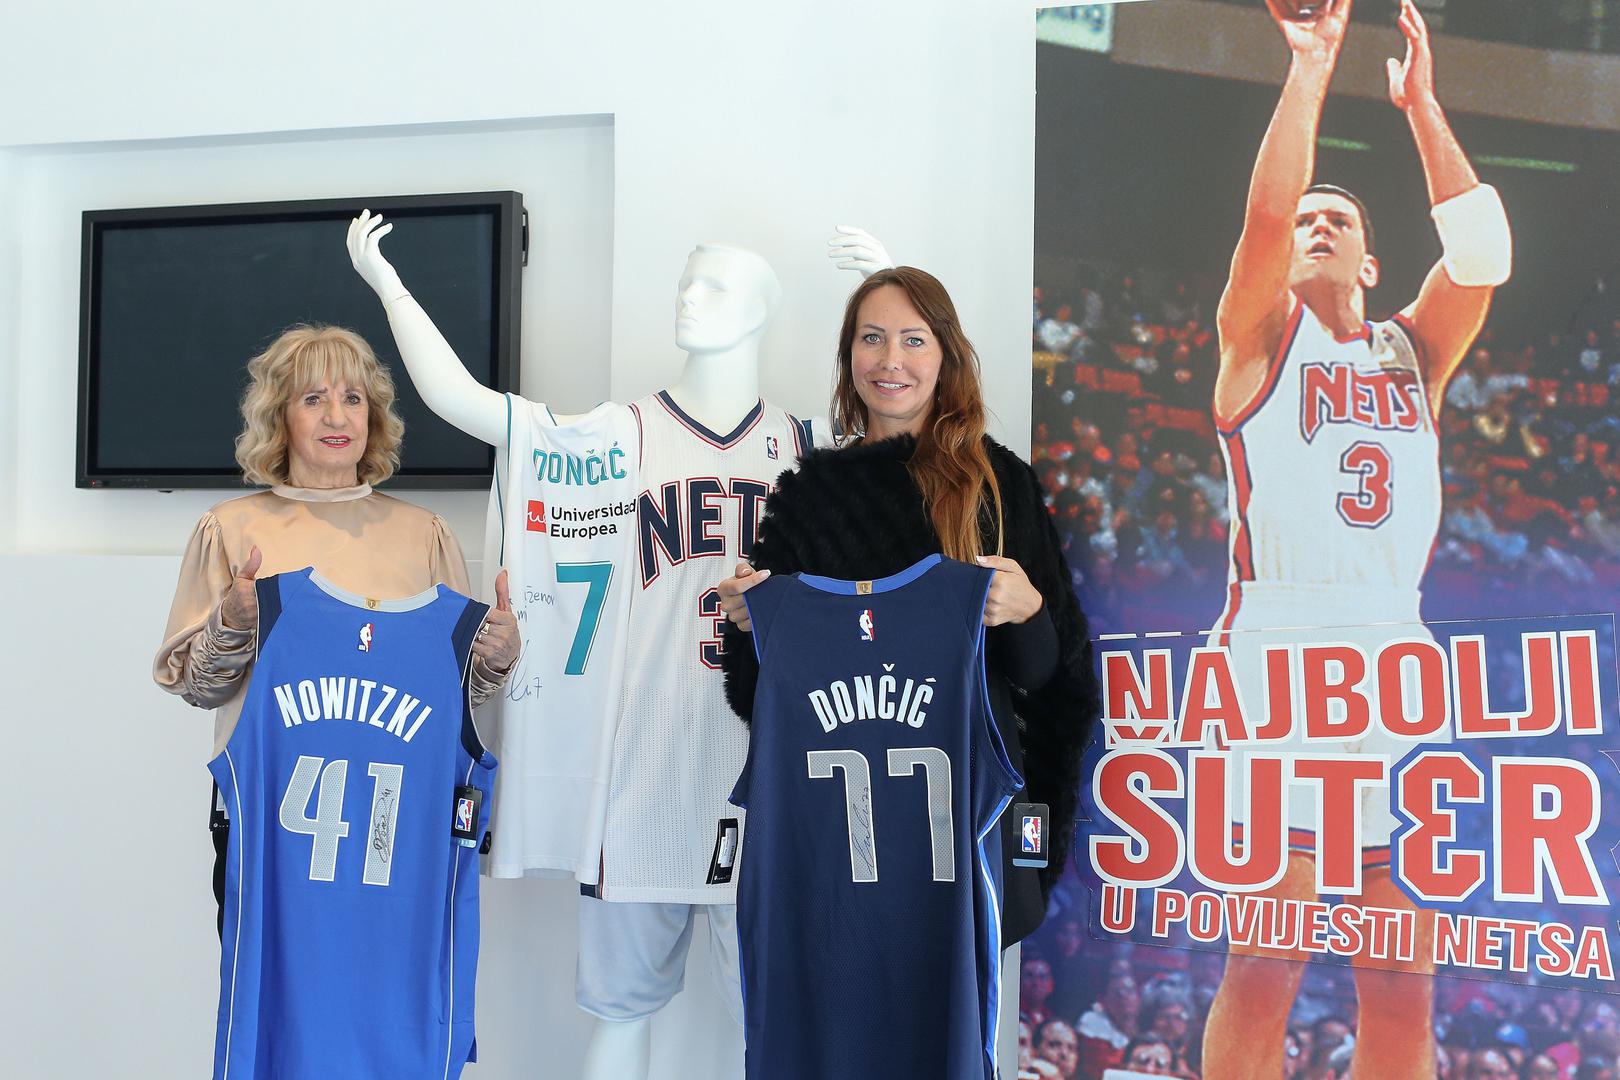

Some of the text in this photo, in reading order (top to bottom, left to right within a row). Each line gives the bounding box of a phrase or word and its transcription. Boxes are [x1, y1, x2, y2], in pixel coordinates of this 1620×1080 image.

[1300, 361, 1419, 444] NETS
[533, 441, 627, 486] DONČIĆ
[1336, 440, 1393, 529] 3
[550, 523, 618, 540] Europea
[551, 498, 637, 522] Universidad
[637, 476, 777, 590] NET
[556, 561, 615, 676] 7
[273, 676, 433, 743] NOWITZKI
[808, 663, 937, 733] DONČIĆ
[1101, 630, 1604, 749] NAJBOLJI
[279, 755, 404, 886] 41
[807, 747, 956, 882] 77
[1100, 882, 1616, 980] U POVIJESTI NETSA
